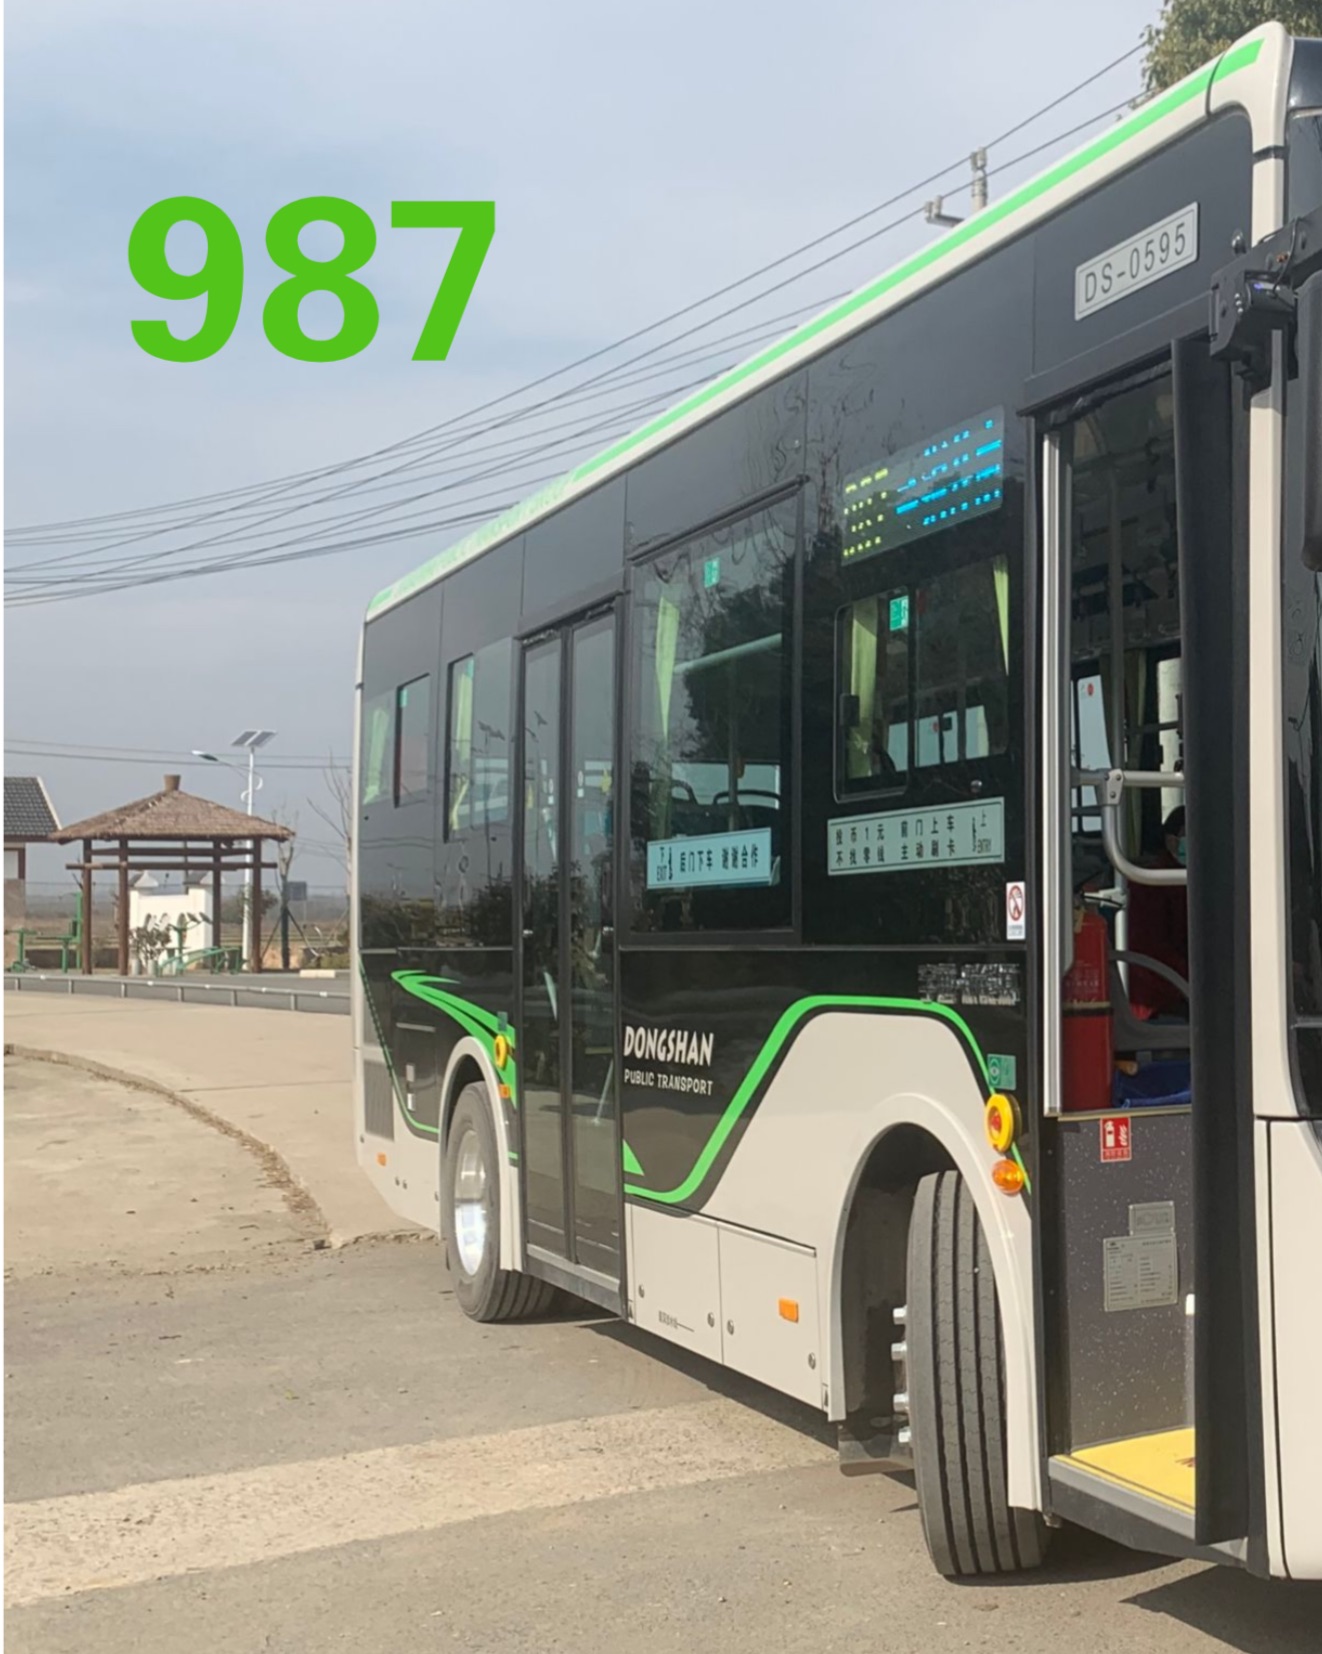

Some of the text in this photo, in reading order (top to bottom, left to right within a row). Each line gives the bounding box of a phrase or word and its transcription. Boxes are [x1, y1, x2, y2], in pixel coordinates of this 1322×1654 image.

[1083, 231, 1189, 304] DS-0595
[835, 814, 955, 846] 投币1元 前门上车
[680, 847, 713, 873] 后门下车
[623, 1025, 714, 1066] DONGSHAN
[624, 1069, 713, 1095] PUBLIC TRANSPORT
